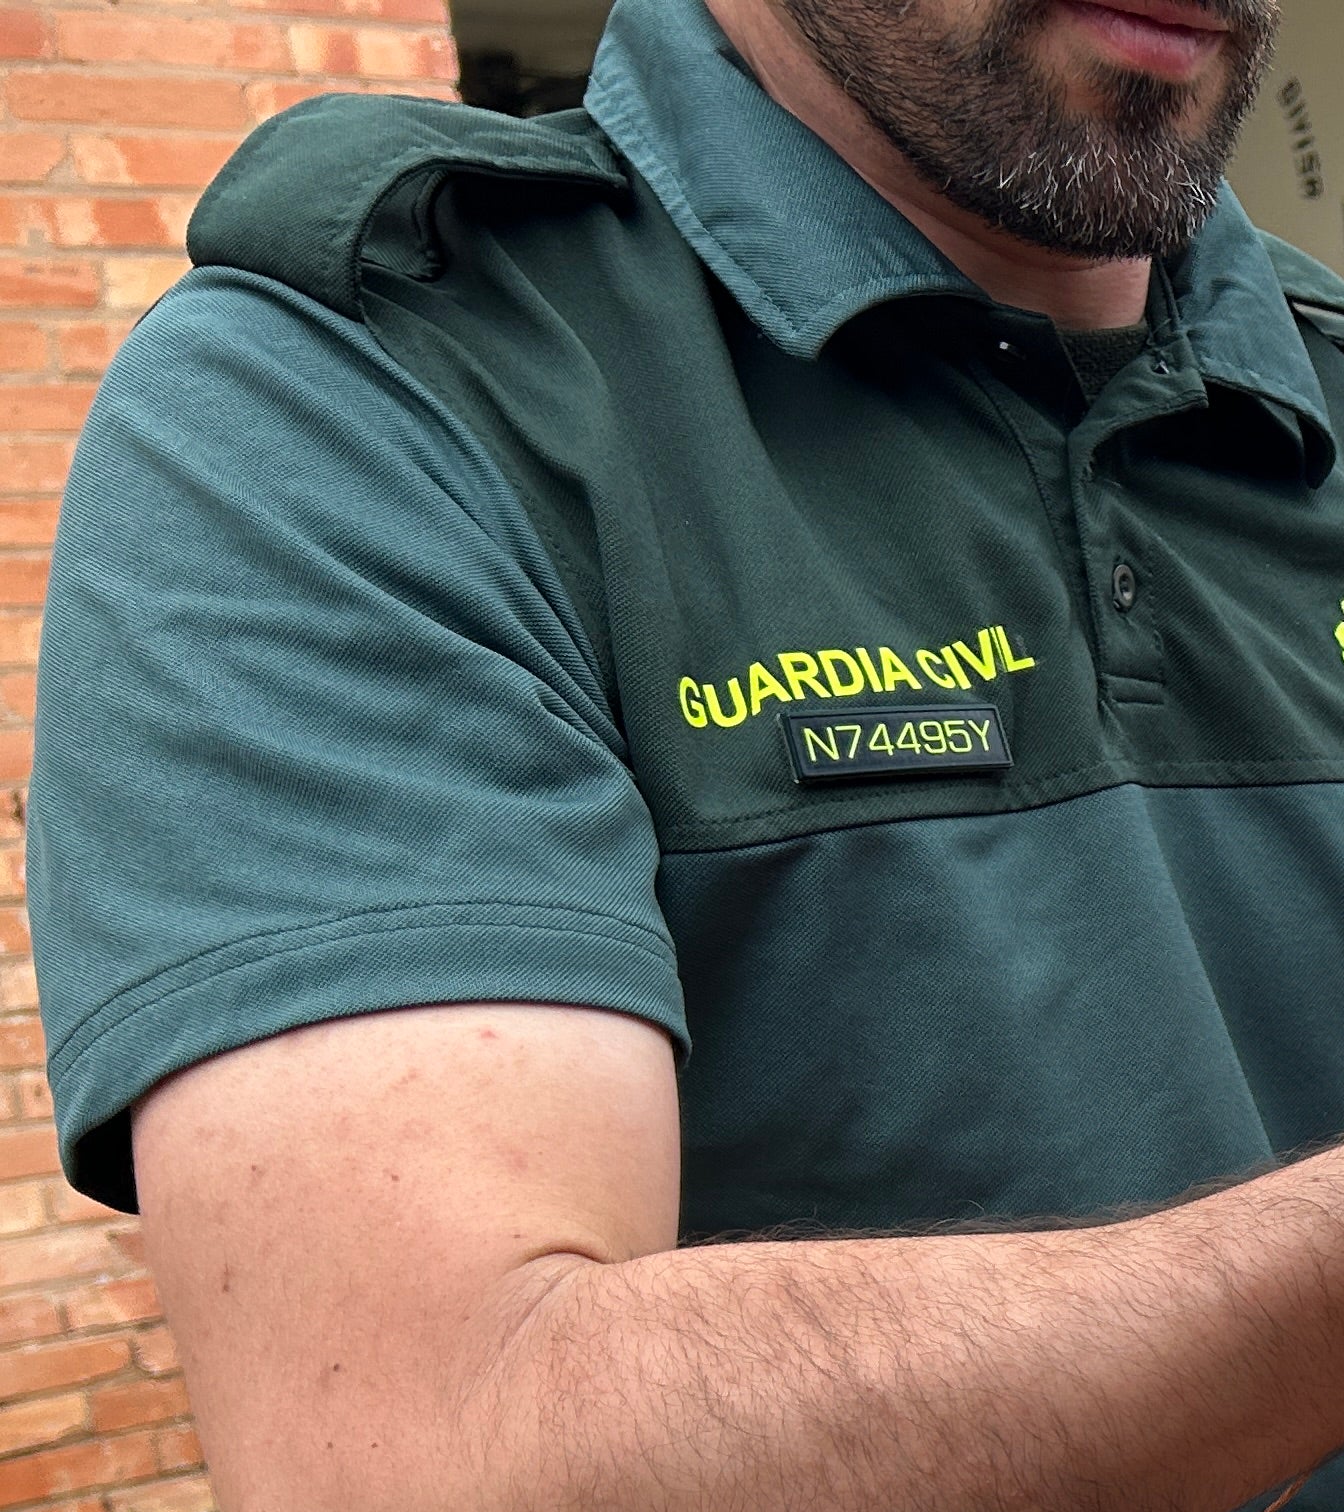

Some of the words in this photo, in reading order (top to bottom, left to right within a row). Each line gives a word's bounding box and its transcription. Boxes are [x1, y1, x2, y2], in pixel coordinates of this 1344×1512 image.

[679, 646, 923, 729] GUARDIA
[915, 625, 1036, 690] CIVIL
[802, 718, 991, 763] N74495Y
